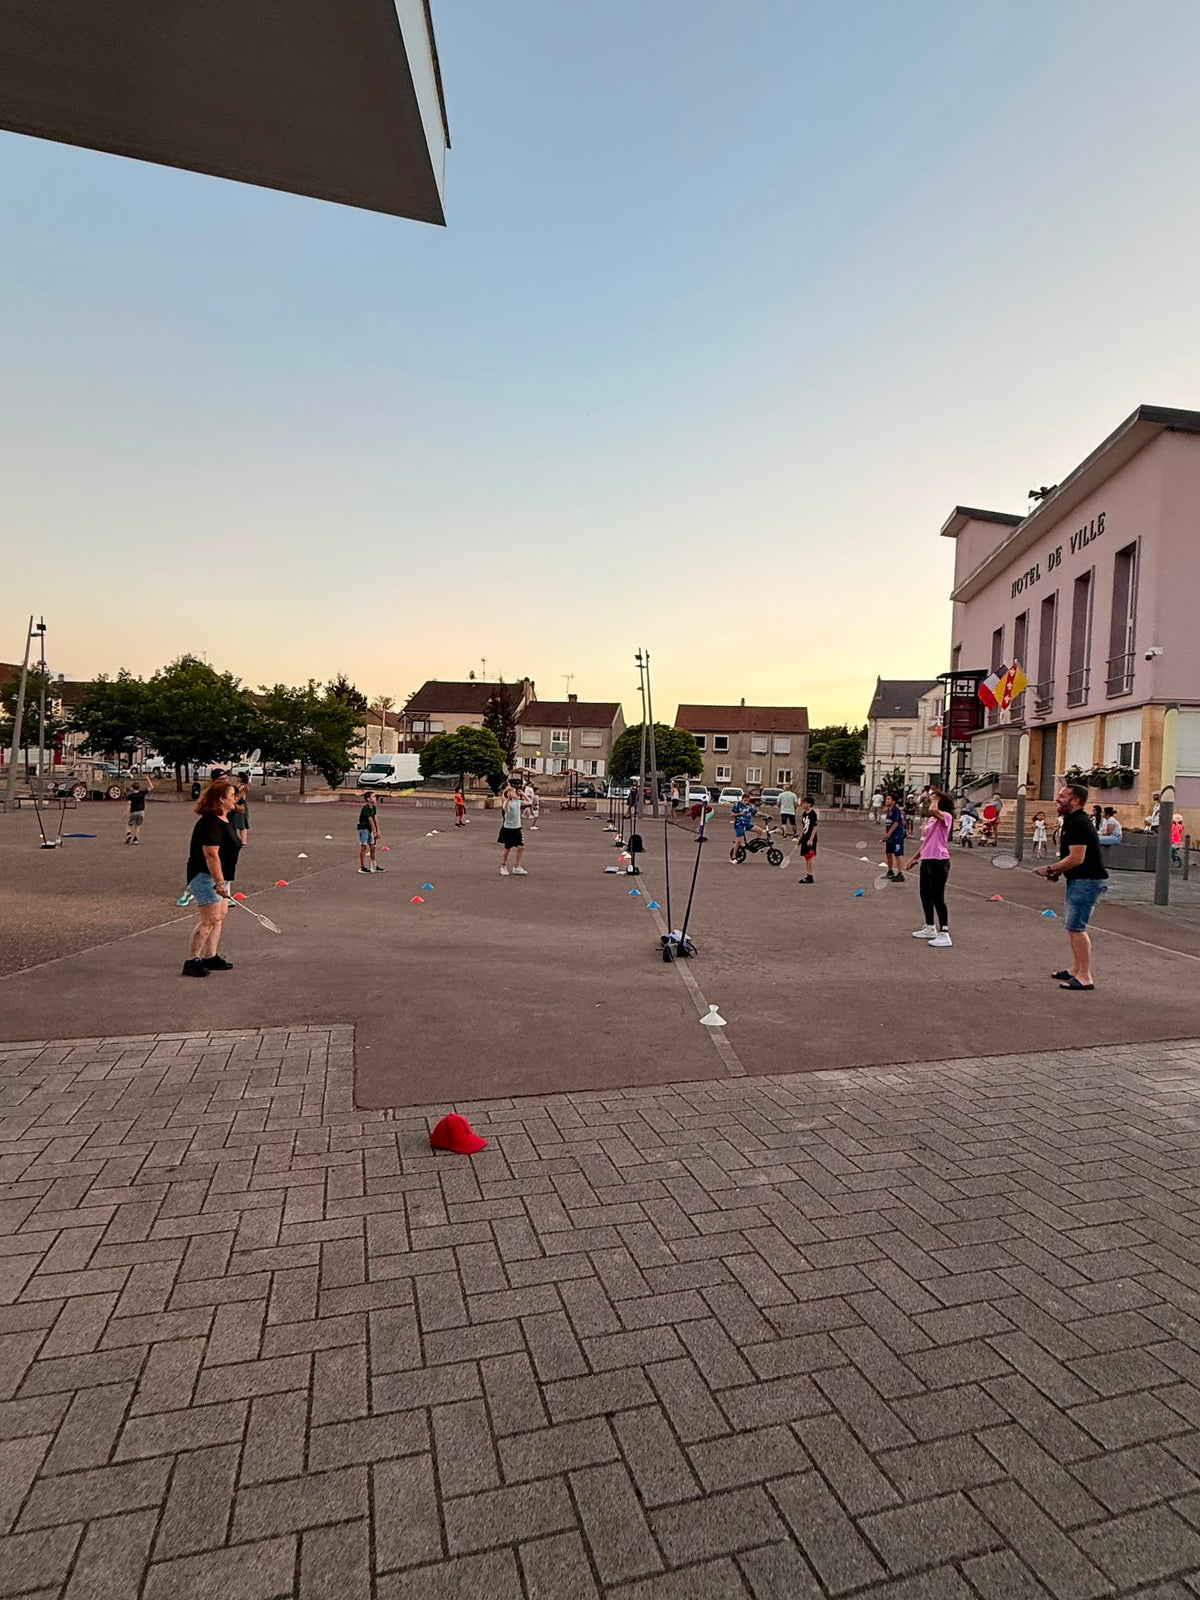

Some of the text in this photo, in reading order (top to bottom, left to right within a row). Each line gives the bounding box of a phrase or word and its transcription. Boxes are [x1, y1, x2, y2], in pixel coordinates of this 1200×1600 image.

[1011, 511, 1106, 599] HOTEL DE VILLE
